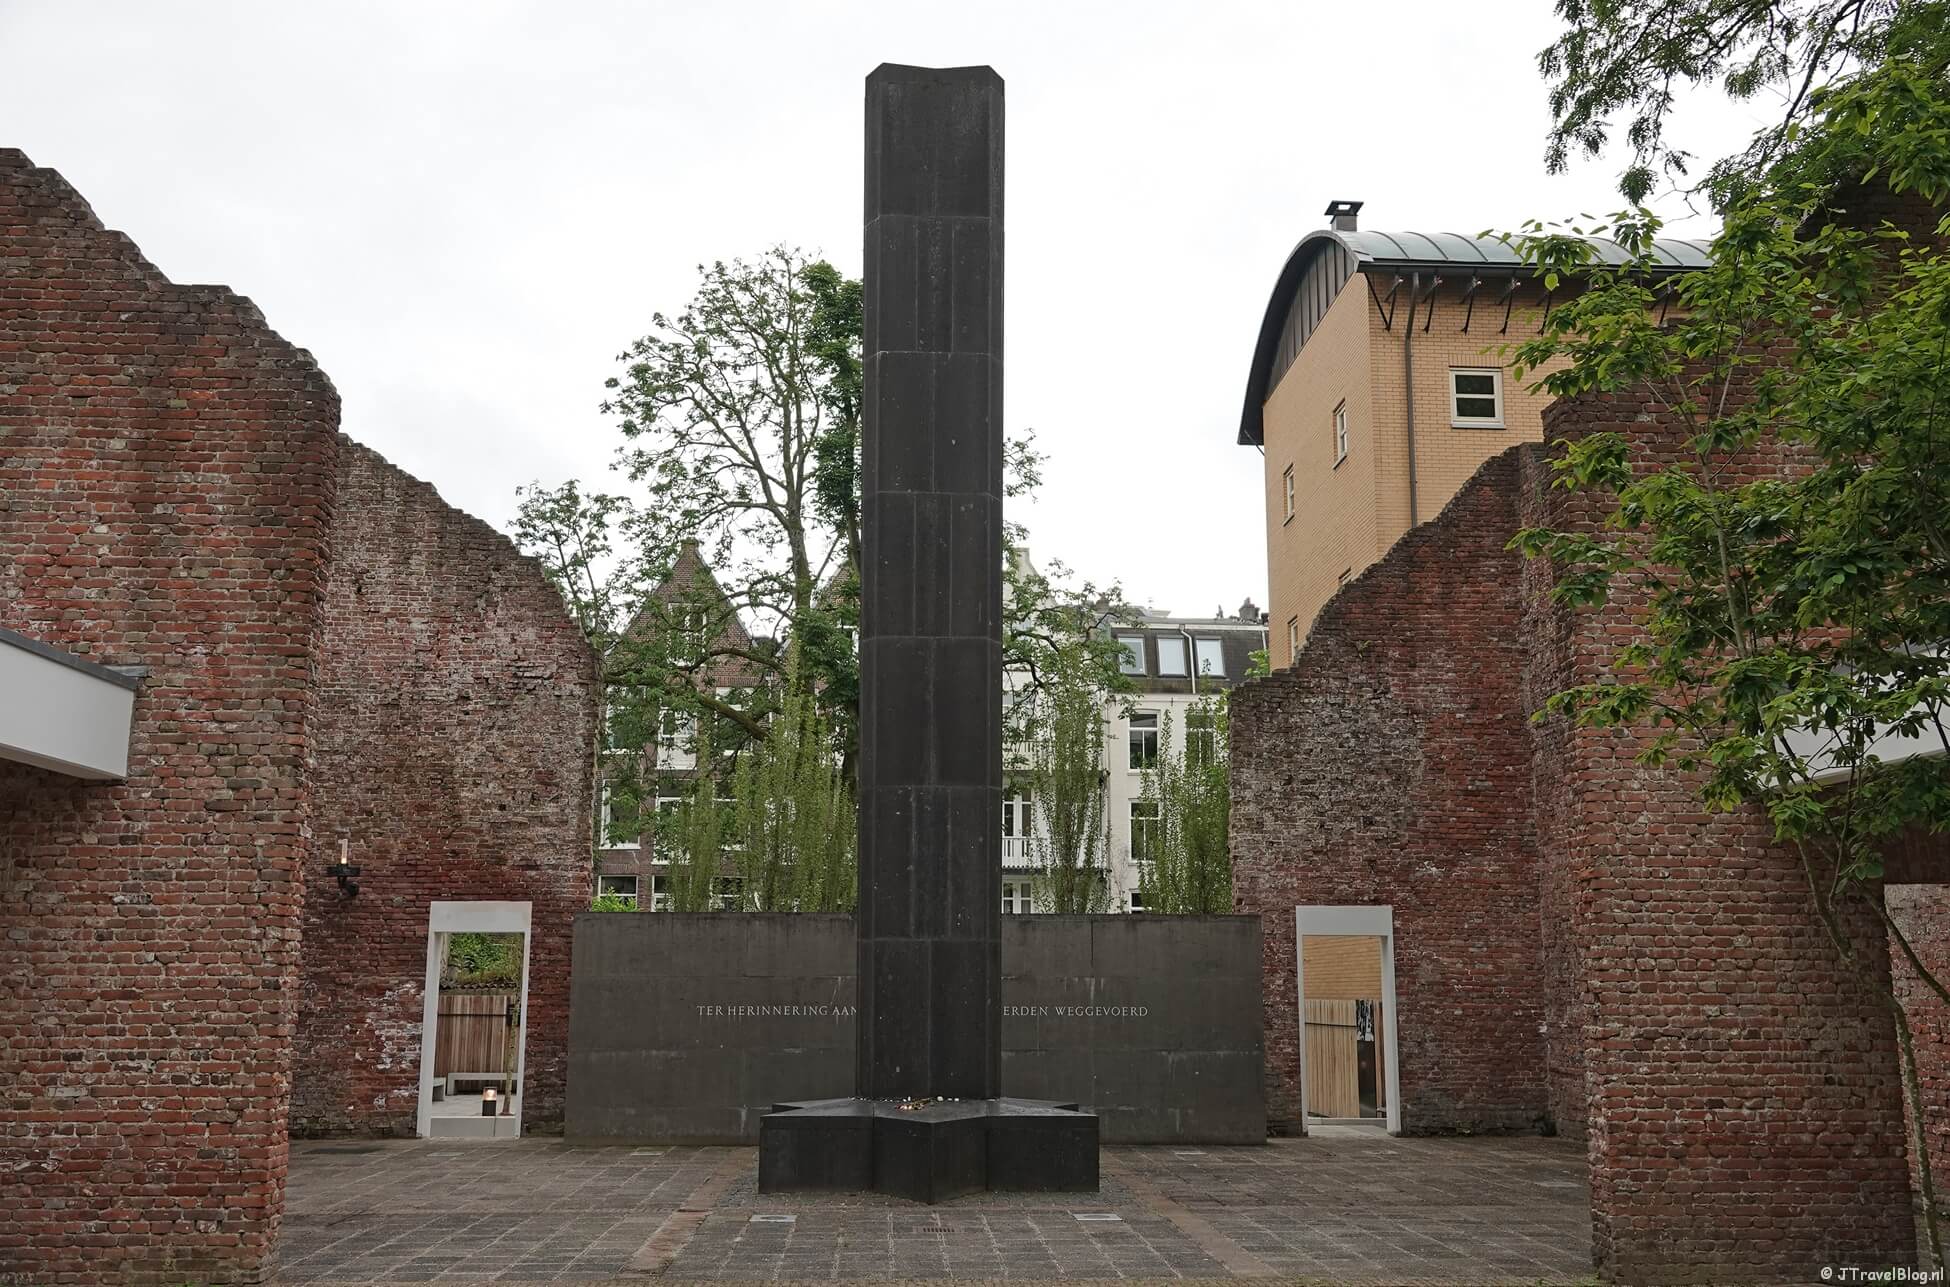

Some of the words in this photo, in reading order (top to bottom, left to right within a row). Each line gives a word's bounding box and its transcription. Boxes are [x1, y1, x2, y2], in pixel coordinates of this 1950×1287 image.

[696, 1005, 724, 1016] TER
[727, 1005, 828, 1016] HERINNERING
[831, 1005, 857, 1016] AAN
[1003, 1005, 1049, 1017] ERDEN
[1055, 1005, 1148, 1017] WEGGEVOERD
